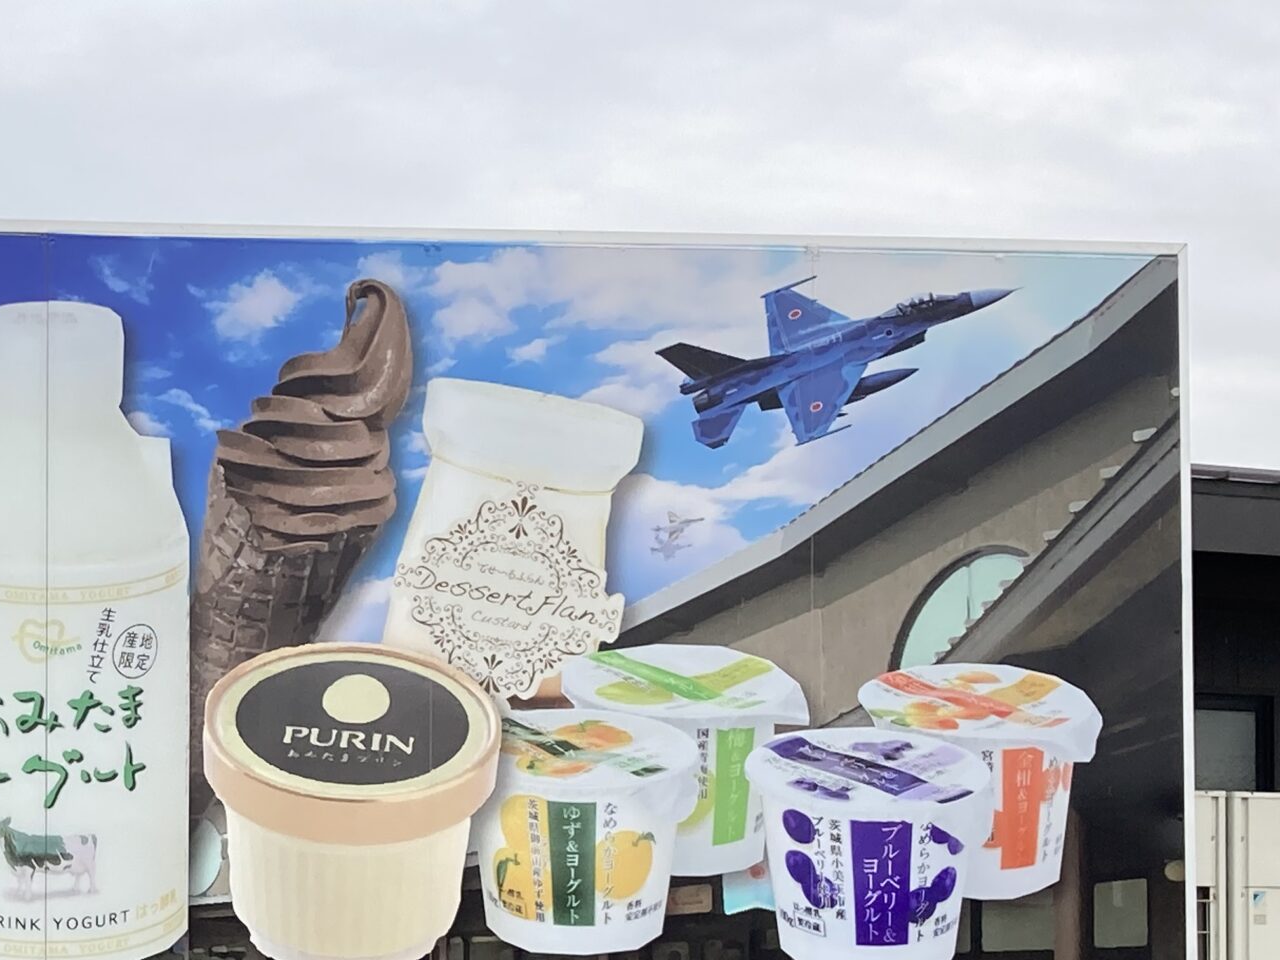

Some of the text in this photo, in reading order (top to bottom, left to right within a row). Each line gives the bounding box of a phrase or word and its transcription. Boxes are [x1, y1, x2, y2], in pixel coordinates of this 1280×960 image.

[412, 565, 598, 625] Dessert Flan
[32, 640, 83, 656] Omitama
[86, 607, 117, 685] 生乳仕立て
[283, 725, 415, 755] PURIN
[562, 806, 582, 925] ゆず&ヨーグルト
[53, 909, 131, 930] YOGURT
[862, 858, 882, 943] ヨーグルト
